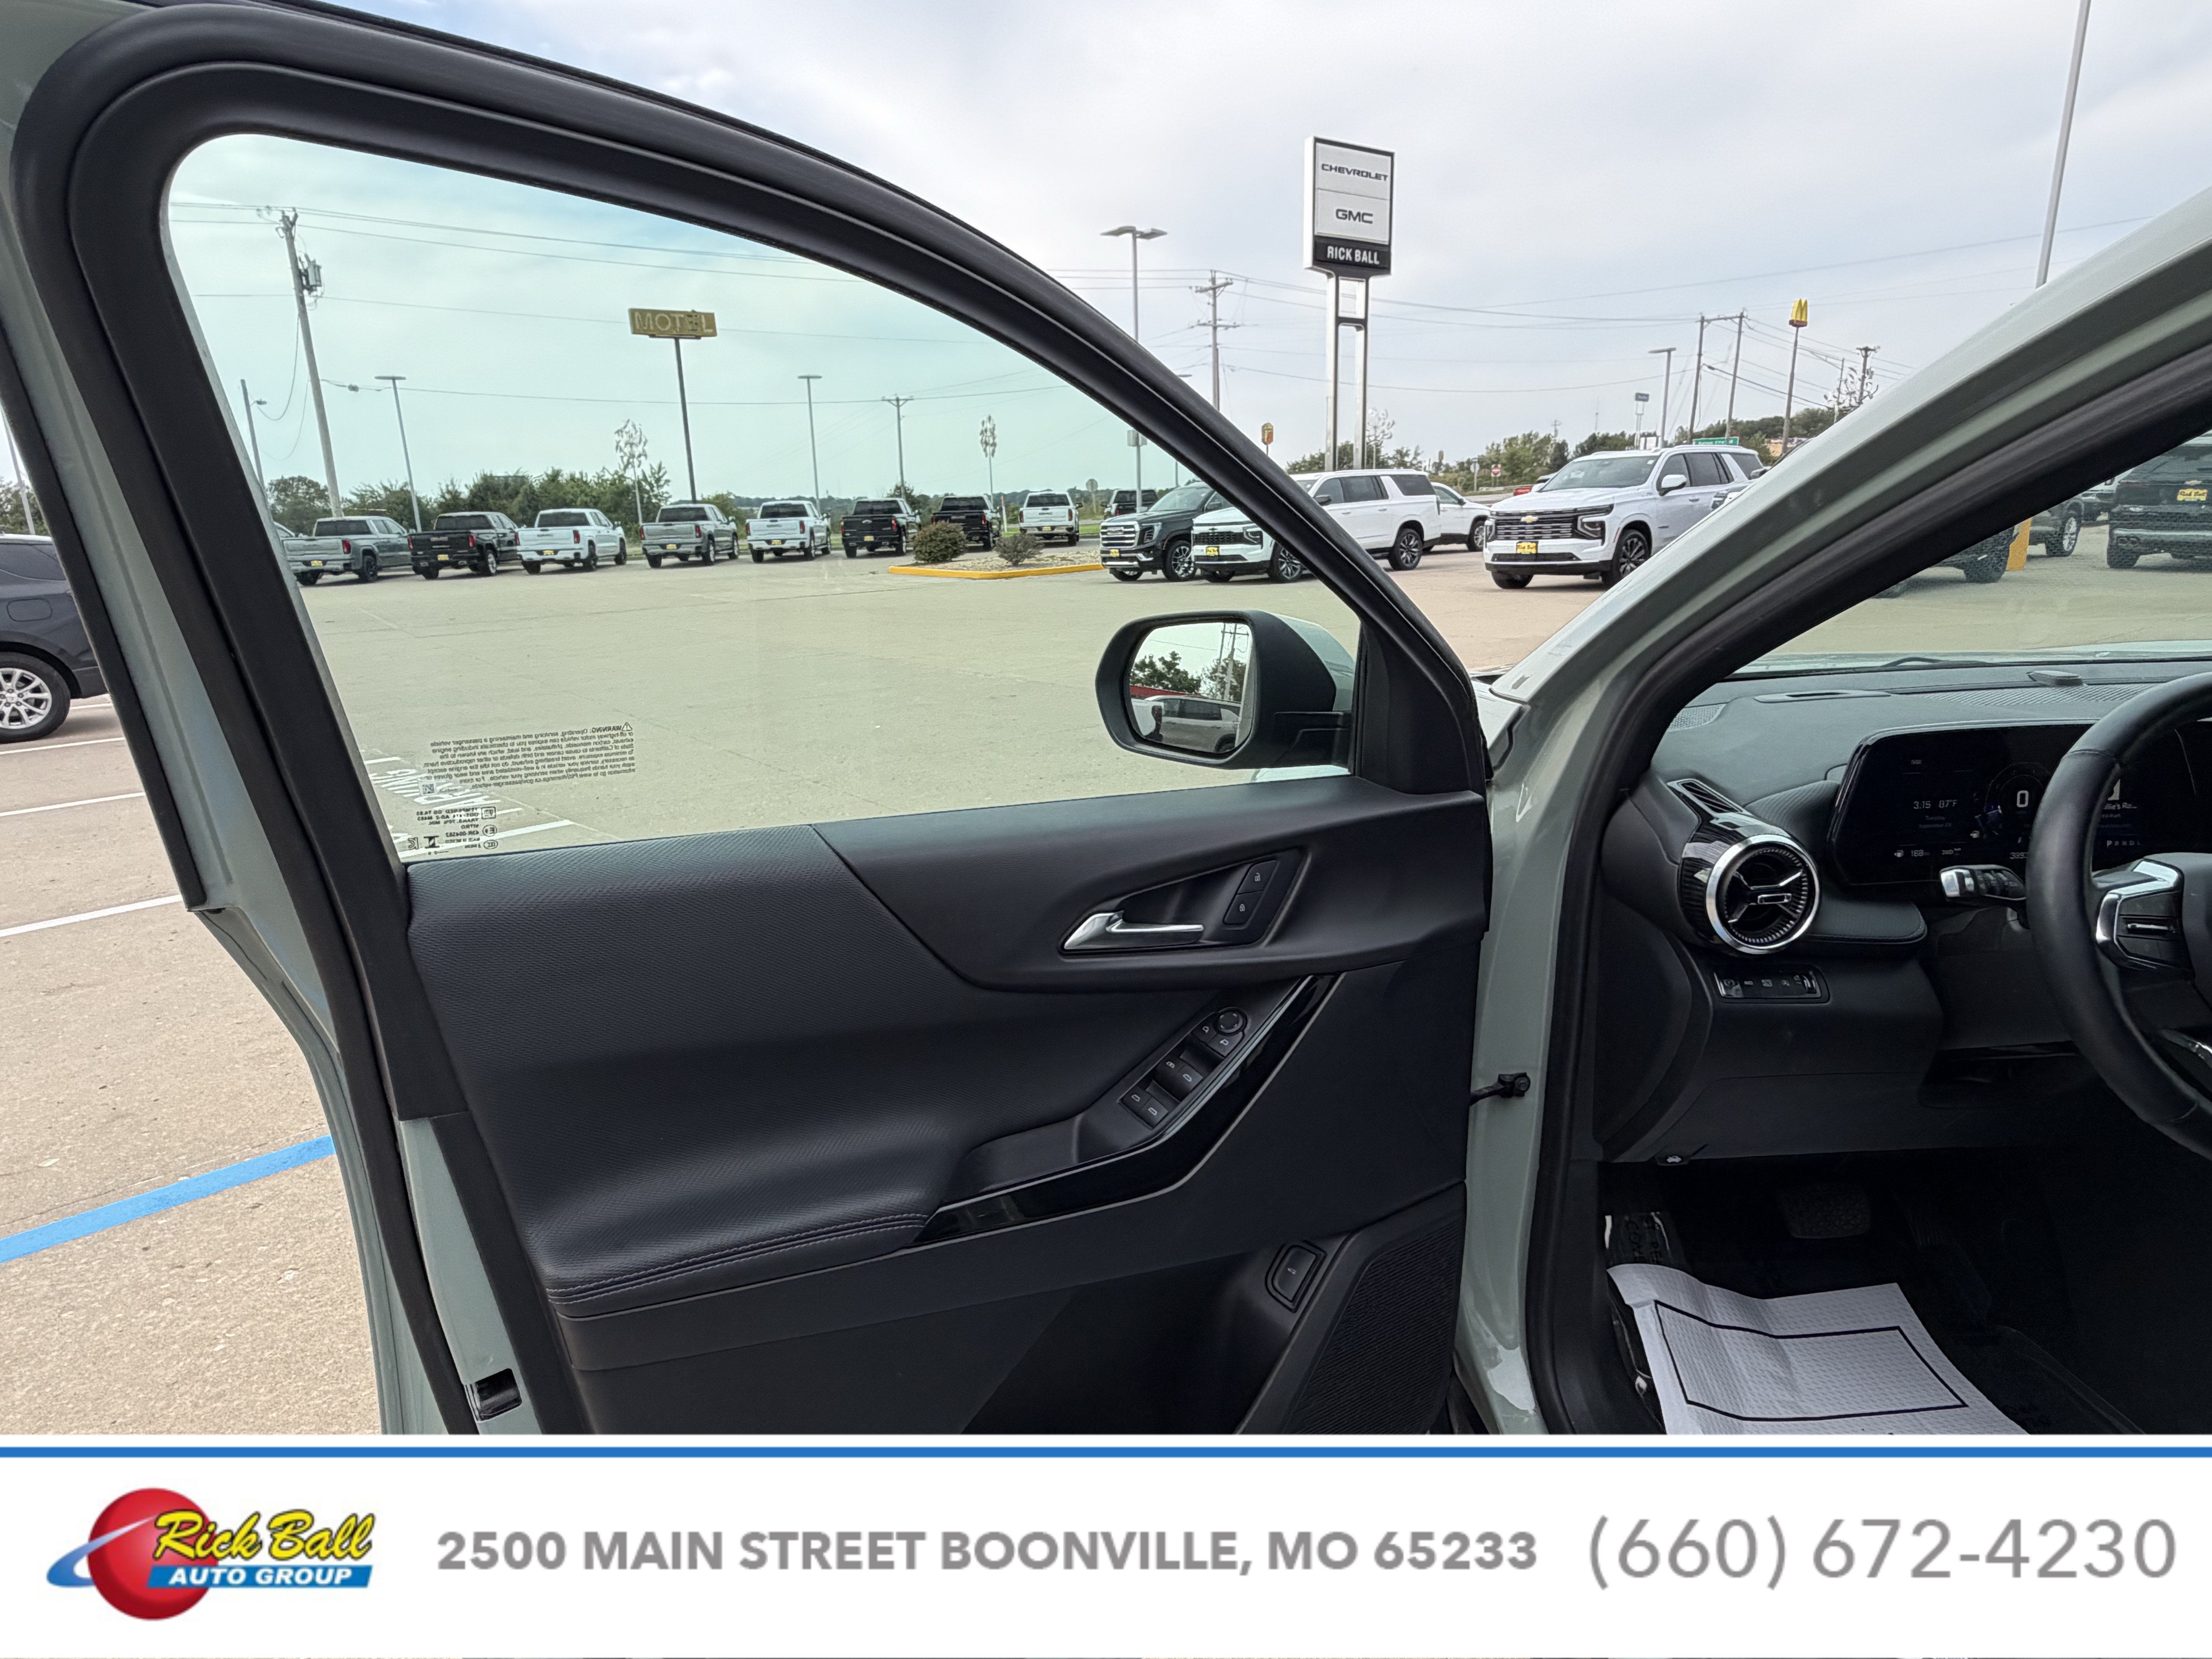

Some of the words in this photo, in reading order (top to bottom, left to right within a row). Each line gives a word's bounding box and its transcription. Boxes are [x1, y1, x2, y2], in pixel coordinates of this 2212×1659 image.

[1321, 163, 1388, 181] CHEVROLET
[1336, 209, 1373, 224] GMC
[1327, 246, 1352, 261] RICK
[1355, 249, 1379, 264] BALL
[2016, 790, 2029, 807] 0
